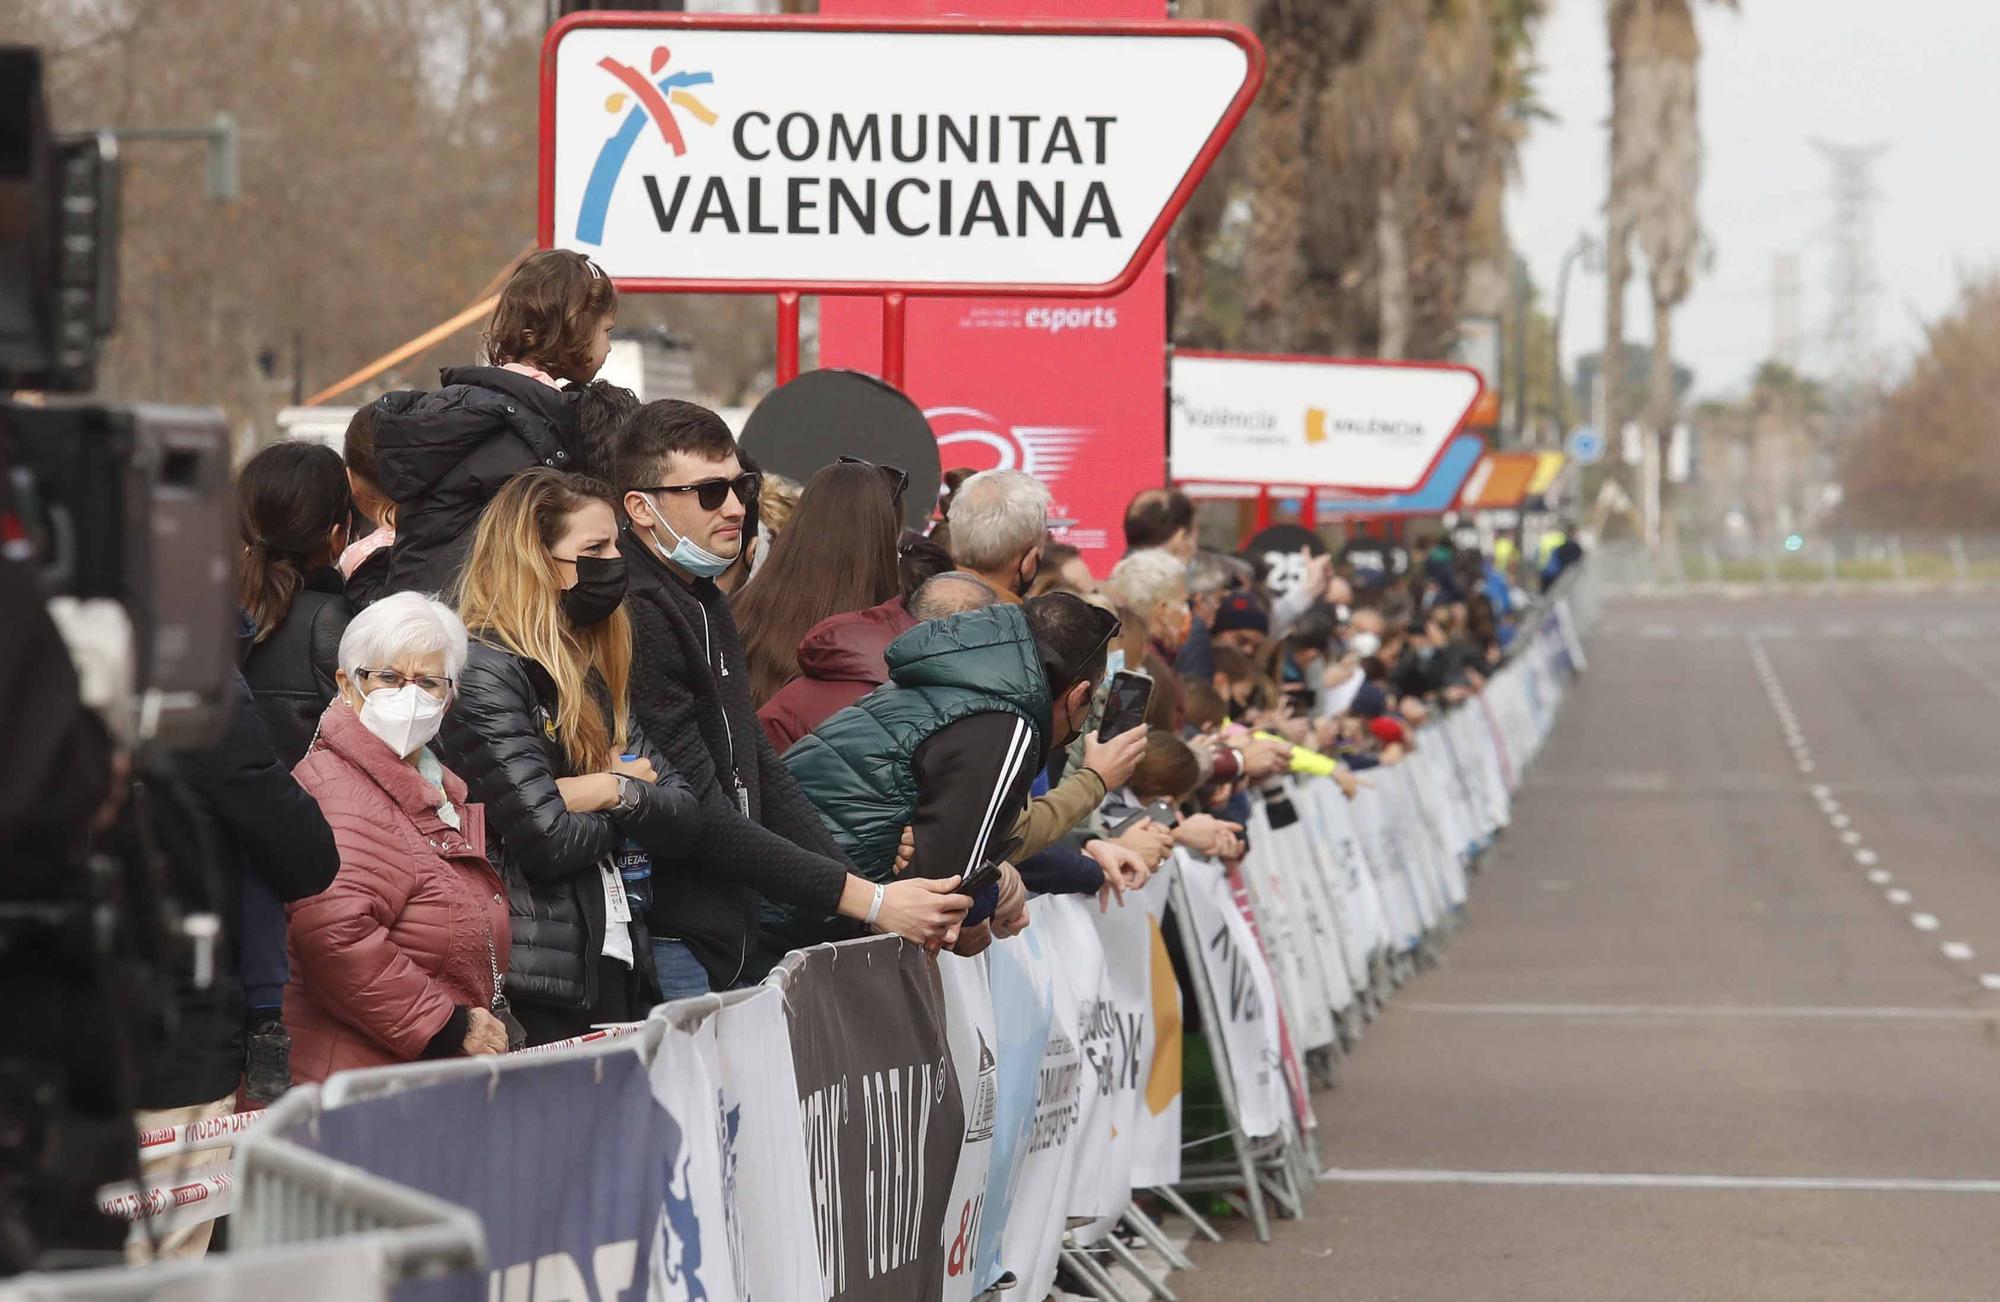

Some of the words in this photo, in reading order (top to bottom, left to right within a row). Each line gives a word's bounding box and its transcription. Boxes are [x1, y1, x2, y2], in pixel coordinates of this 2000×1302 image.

[733, 111, 1118, 165] COMUNITAT
[642, 175, 1123, 239] VALENCIANA
[1025, 306, 1117, 333] esports
